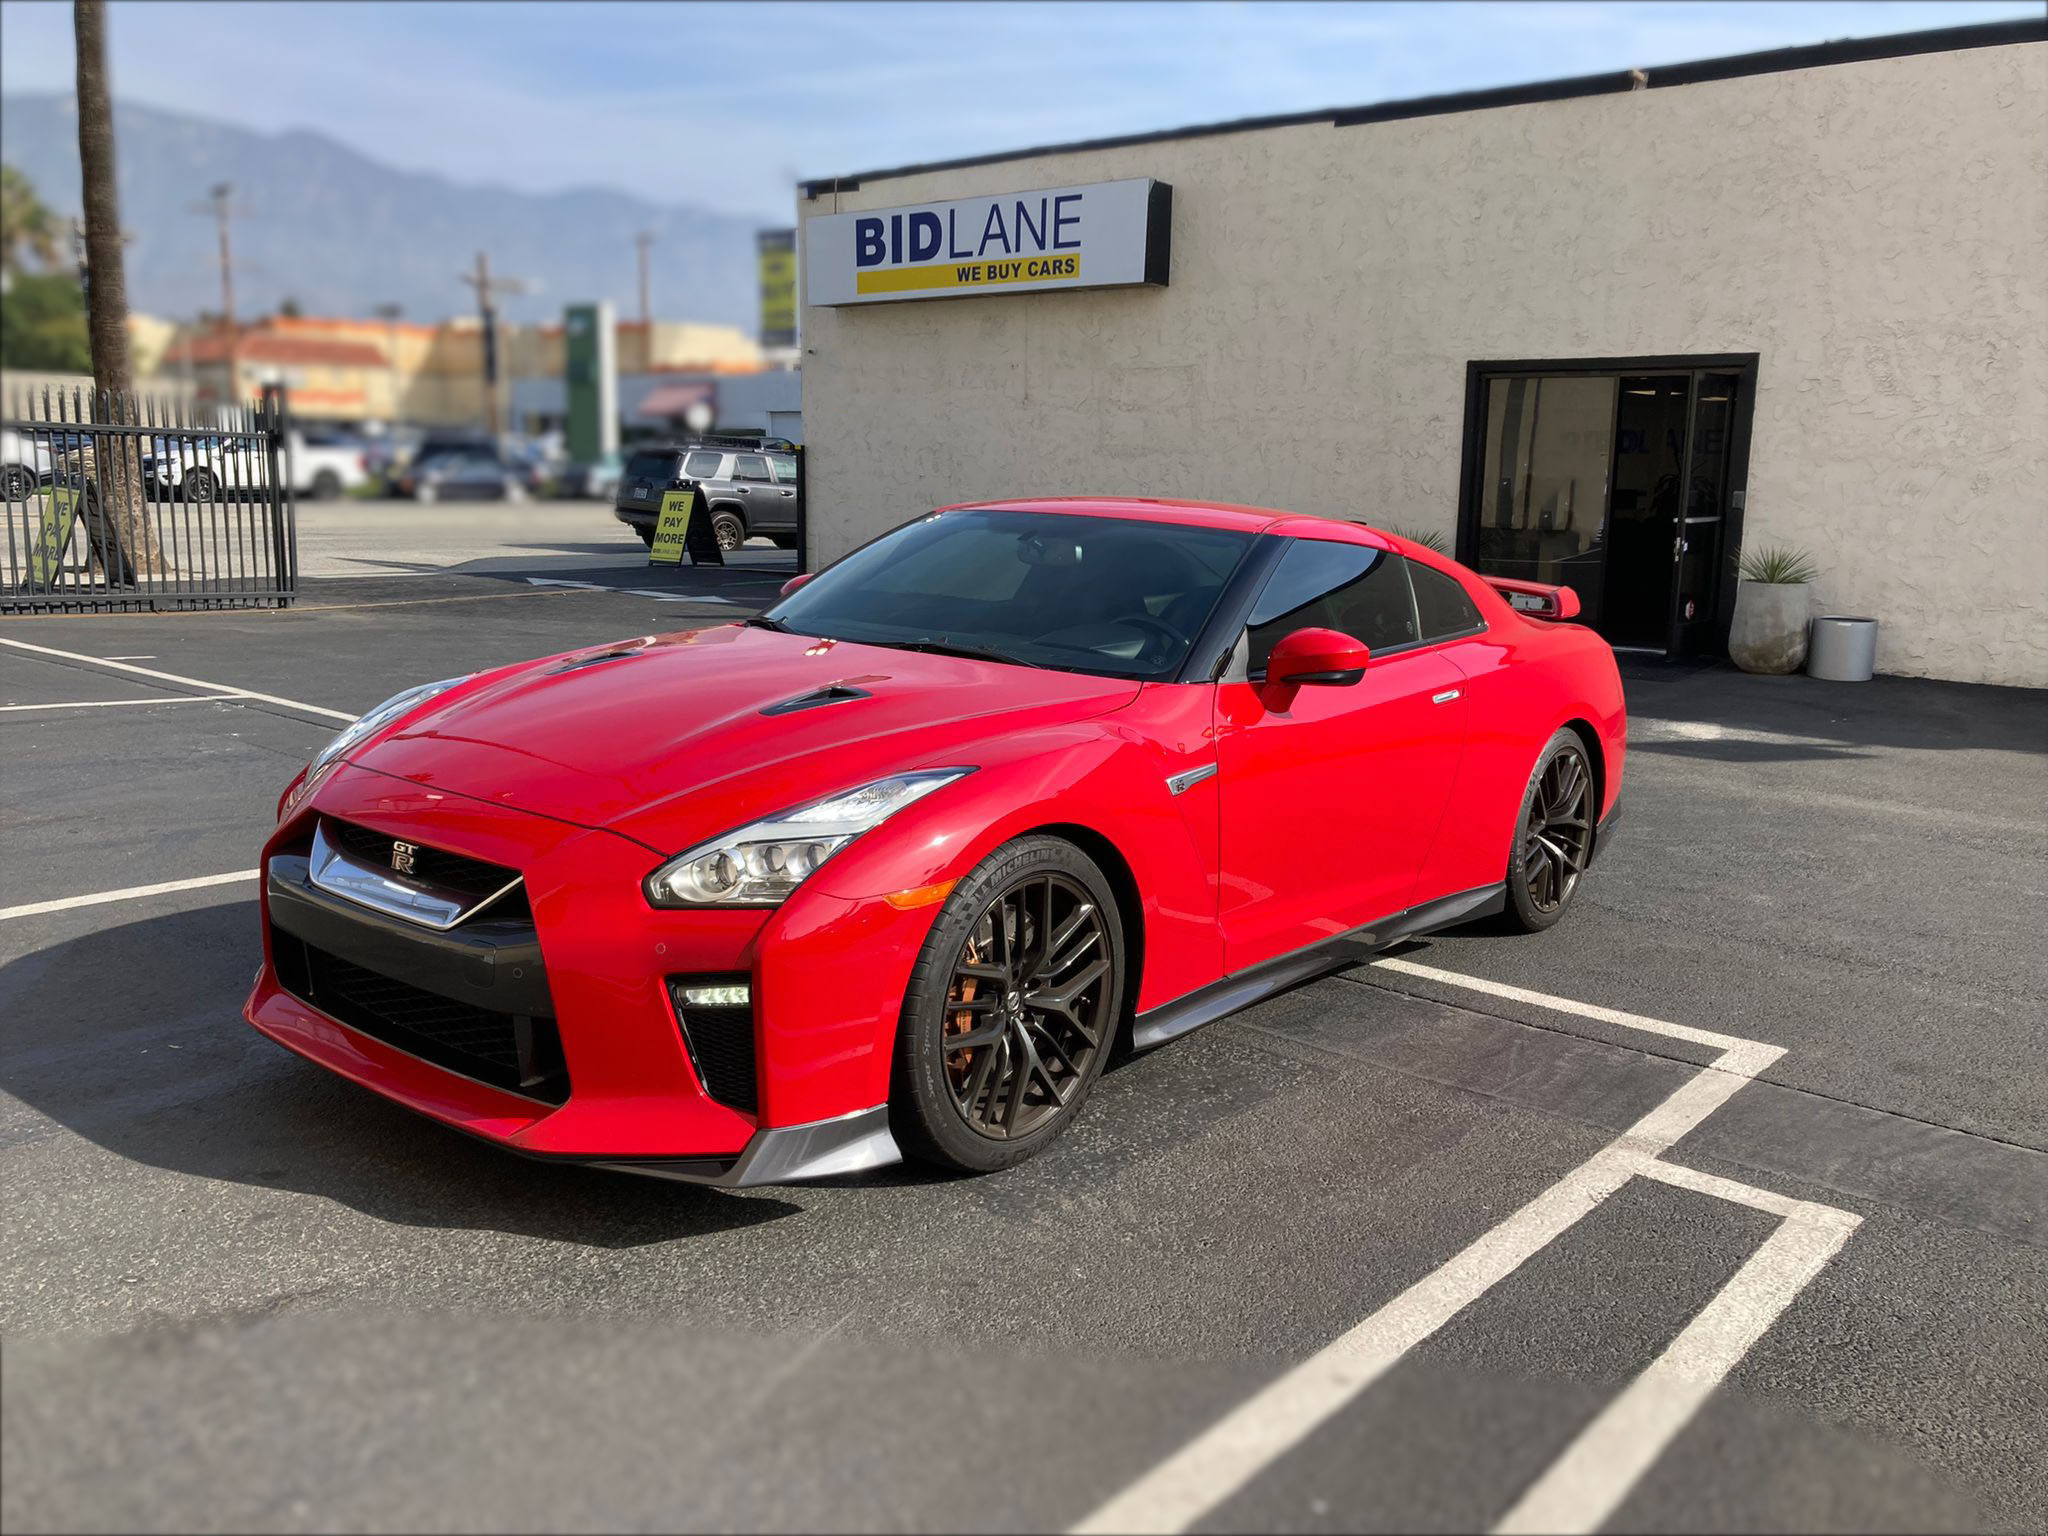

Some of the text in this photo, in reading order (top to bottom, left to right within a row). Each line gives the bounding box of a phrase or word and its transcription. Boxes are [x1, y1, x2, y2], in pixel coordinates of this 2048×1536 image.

[856, 194, 1083, 267] BIDLANE
[957, 258, 1075, 282] WE BUY CARS
[669, 501, 684, 511] WE
[663, 517, 683, 527] PAY
[655, 533, 684, 544] MORE
[33, 543, 61, 561] MR
[990, 848, 1053, 887] MICHELIN
